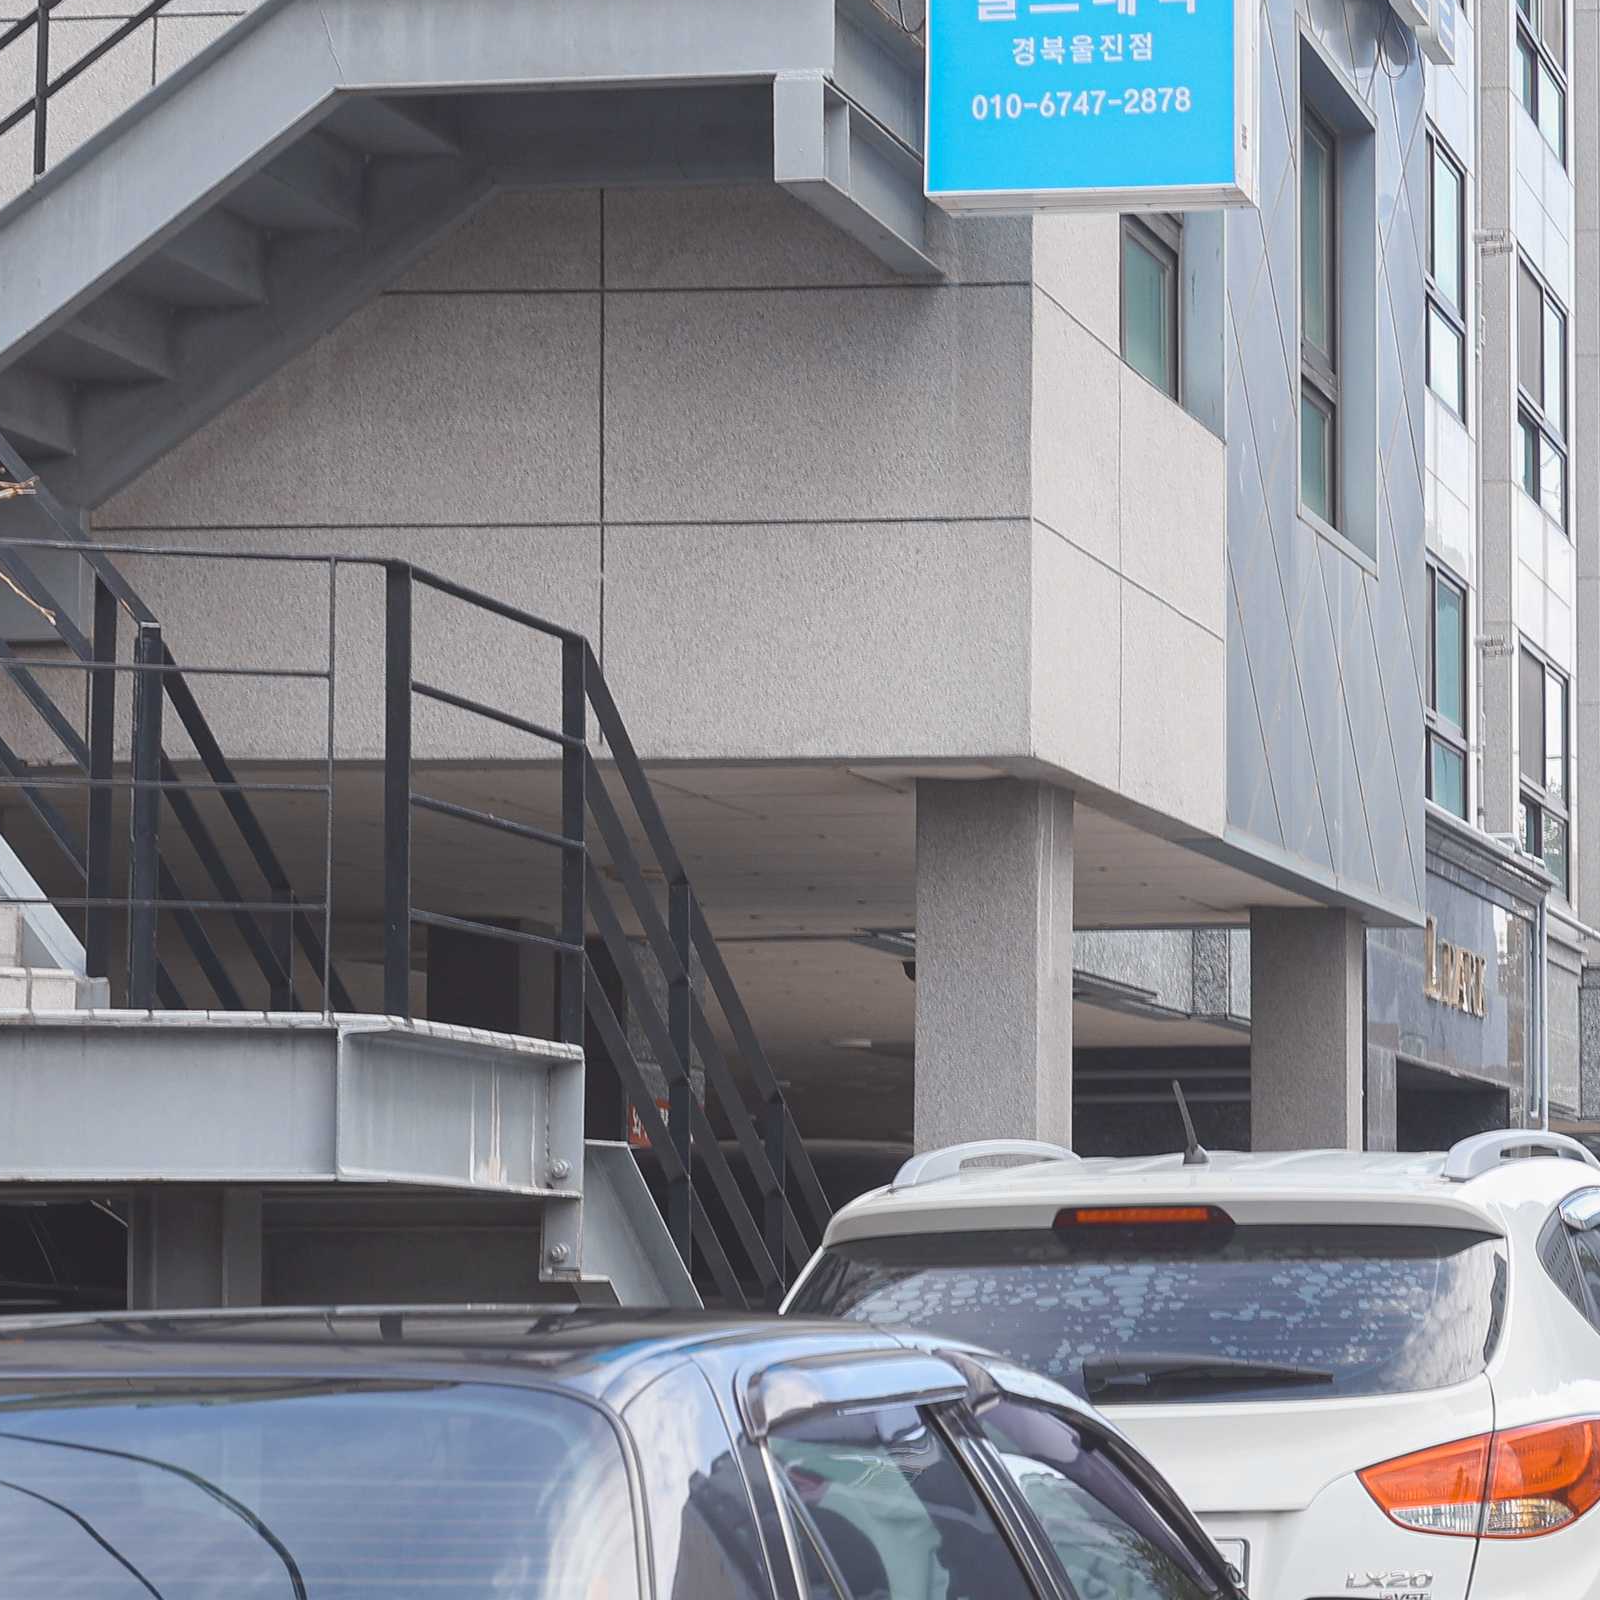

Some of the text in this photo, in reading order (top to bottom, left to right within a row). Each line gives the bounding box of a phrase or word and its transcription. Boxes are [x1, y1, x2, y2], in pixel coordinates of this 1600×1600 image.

[1012, 31, 1153, 67] 경북울진점
[971, 86, 1192, 121] 010-6747-2878
[1344, 1569, 1434, 1589] LX20
